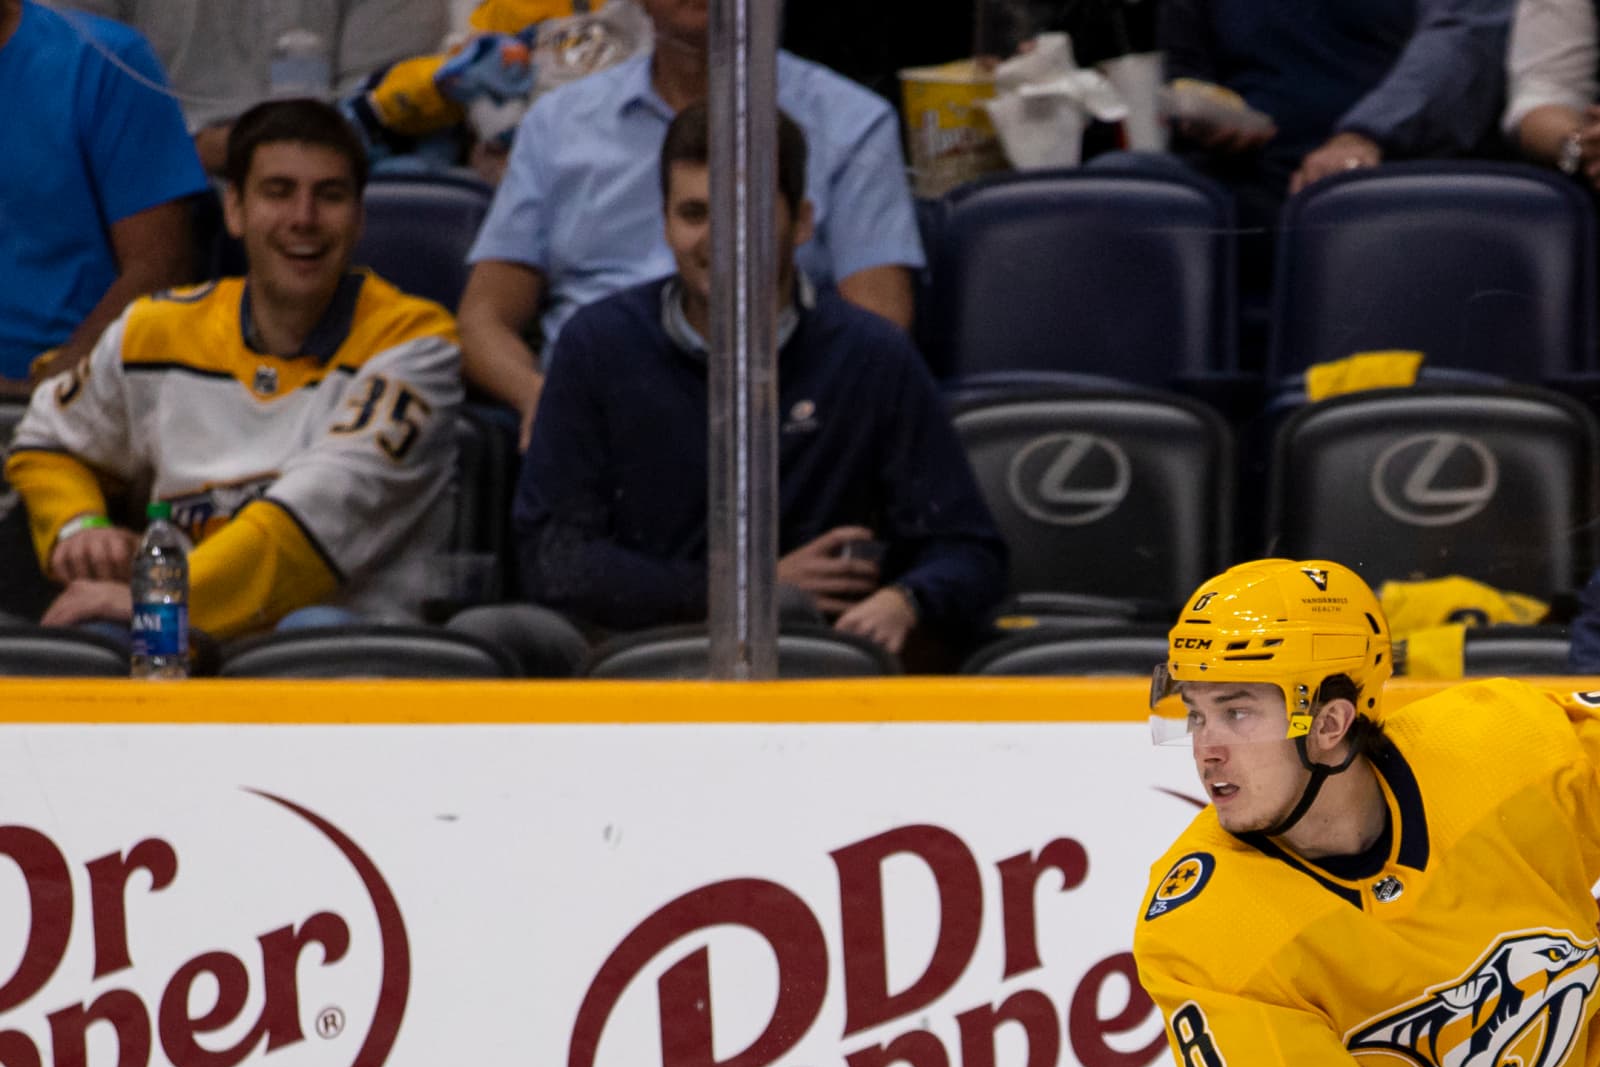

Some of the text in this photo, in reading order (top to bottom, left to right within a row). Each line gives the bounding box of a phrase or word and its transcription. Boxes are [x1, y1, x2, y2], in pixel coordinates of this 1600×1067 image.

[331, 374, 433, 462] 35
[1174, 637, 1213, 650] CCM
[829, 824, 1089, 1038] Dr
